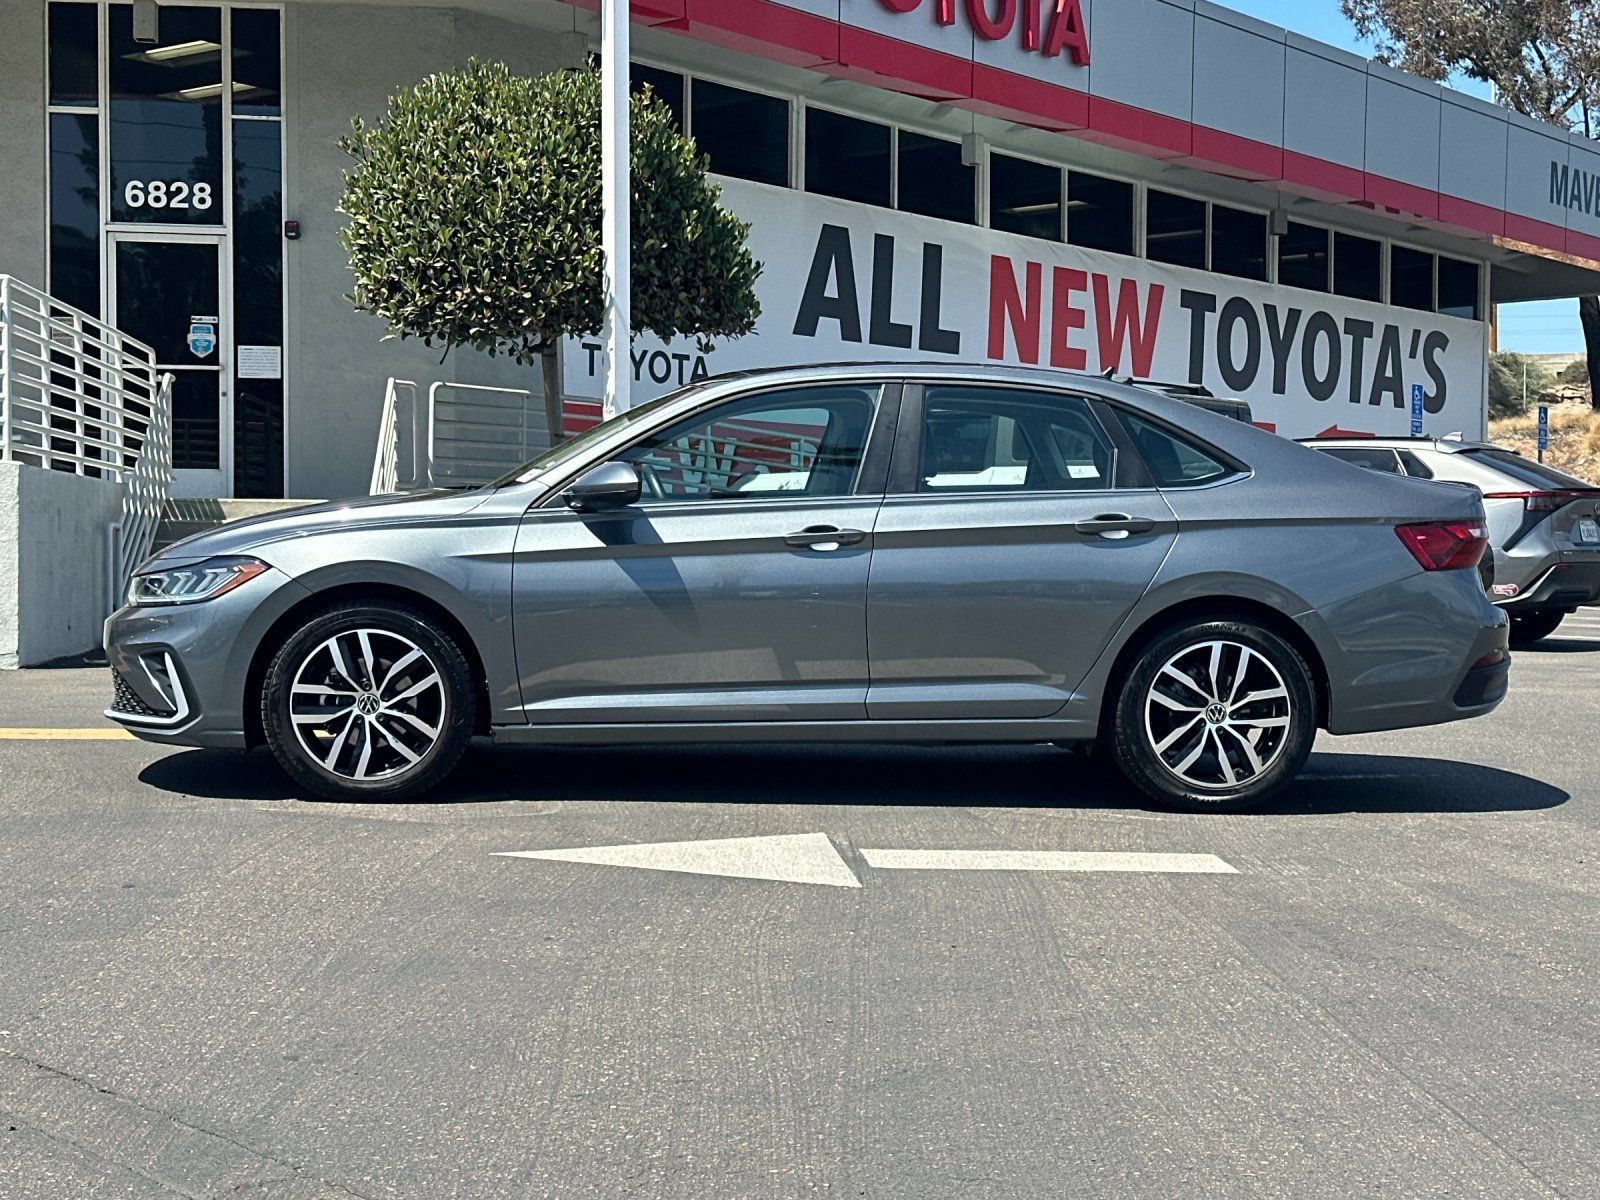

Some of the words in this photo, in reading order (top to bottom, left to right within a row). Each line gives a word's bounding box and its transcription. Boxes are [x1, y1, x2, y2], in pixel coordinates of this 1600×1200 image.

[875, 0, 1091, 67] OTA
[125, 180, 212, 210] 6828
[792, 223, 961, 355] ALL
[987, 254, 1165, 379] NEW
[1180, 288, 1450, 414] TOYOTA'S
[581, 342, 709, 386] TYOTA
[1206, 703, 1227, 724] VW
